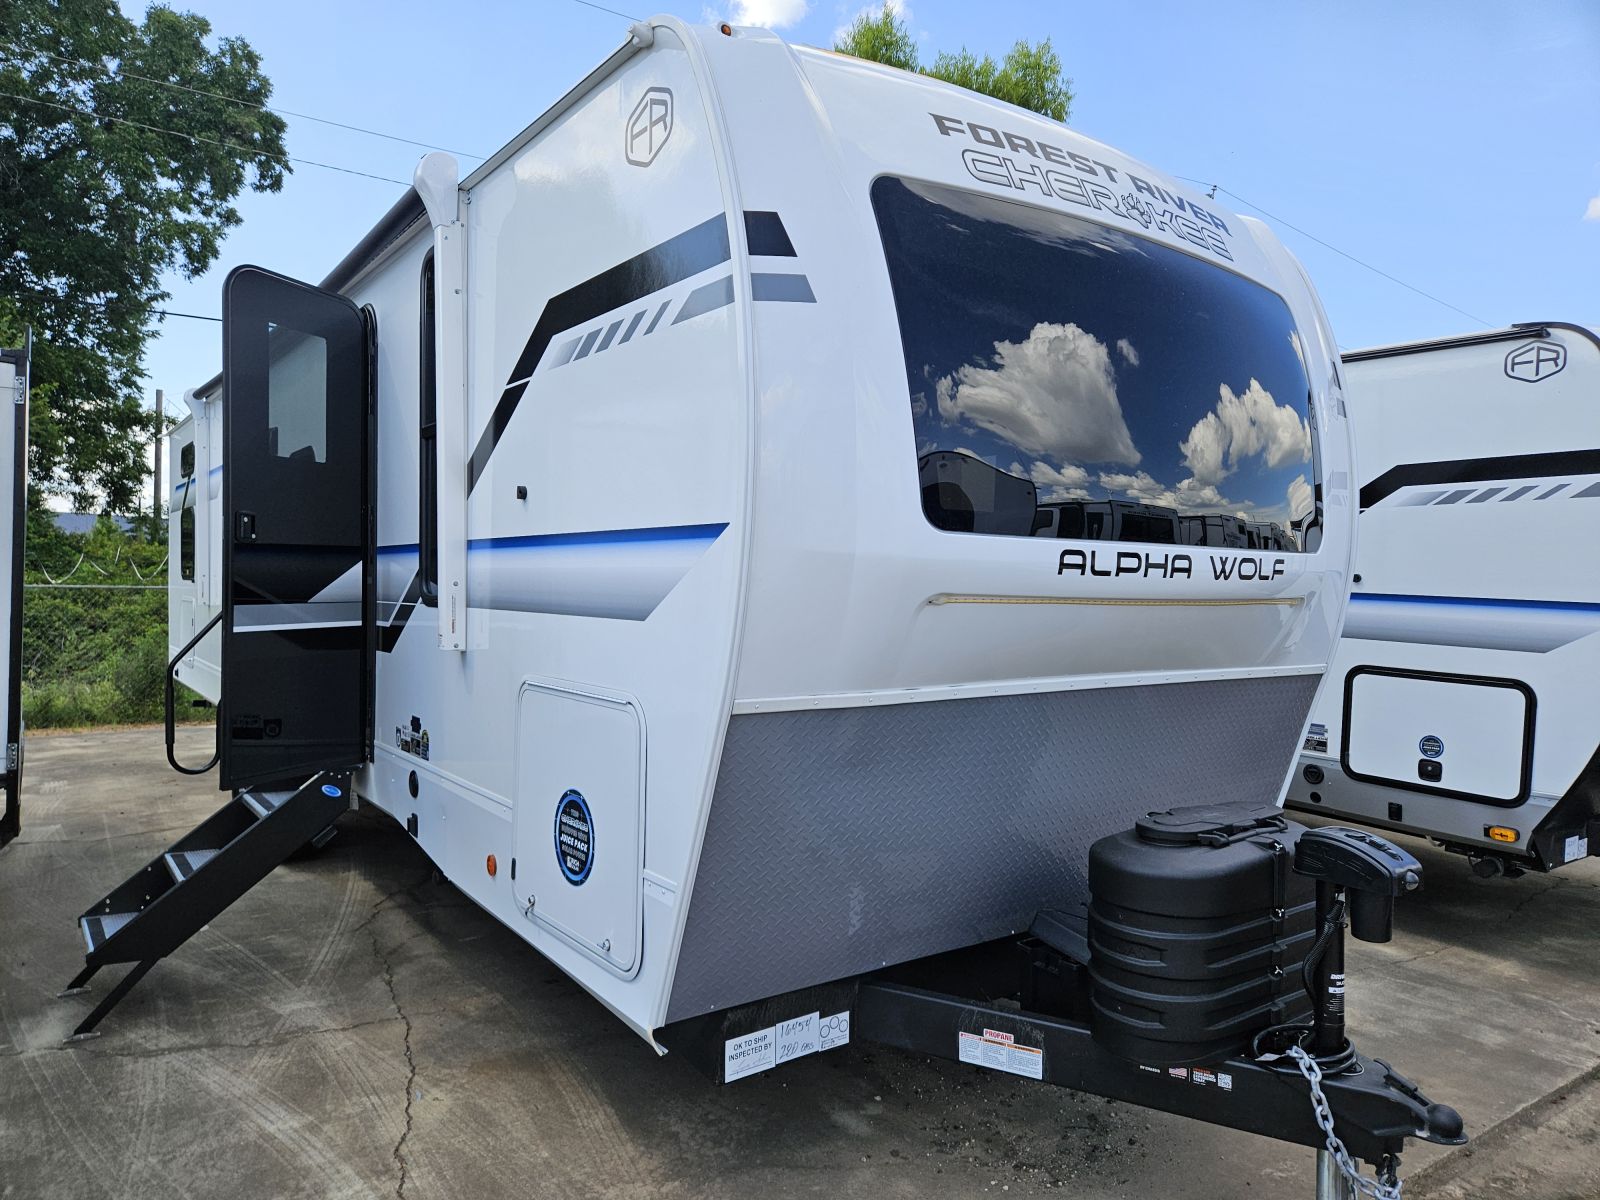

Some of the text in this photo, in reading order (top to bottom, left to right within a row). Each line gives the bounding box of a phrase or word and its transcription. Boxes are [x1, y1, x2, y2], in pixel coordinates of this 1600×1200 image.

[928, 111, 1233, 238] FOREST RIVER
[1056, 548, 1286, 582] ALPHA WOLF
[560, 832, 575, 846] JUICE
[574, 839, 589, 853] PACK
[733, 1033, 768, 1052] OK TO SHIP
[984, 1029, 1013, 1042] PROPANE
[728, 1045, 763, 1062] INSPECTED
[763, 1041, 773, 1052] BY
